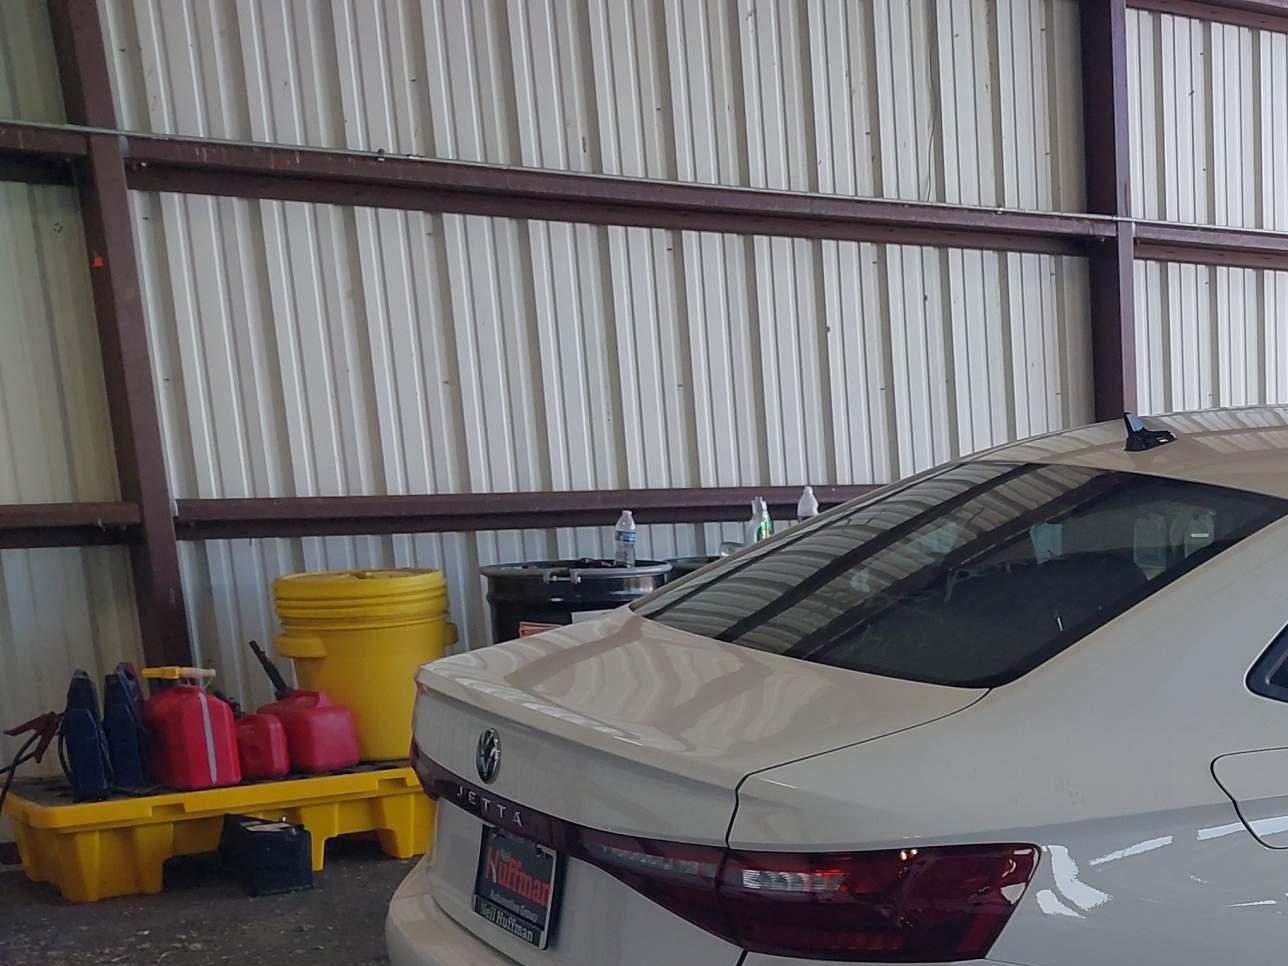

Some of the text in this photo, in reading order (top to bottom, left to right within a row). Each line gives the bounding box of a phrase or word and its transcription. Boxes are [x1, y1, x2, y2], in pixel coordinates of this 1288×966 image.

[456, 785, 523, 828] JETTA
[485, 847, 552, 907] Huffman
[480, 902, 534, 943] Neil Huffman
